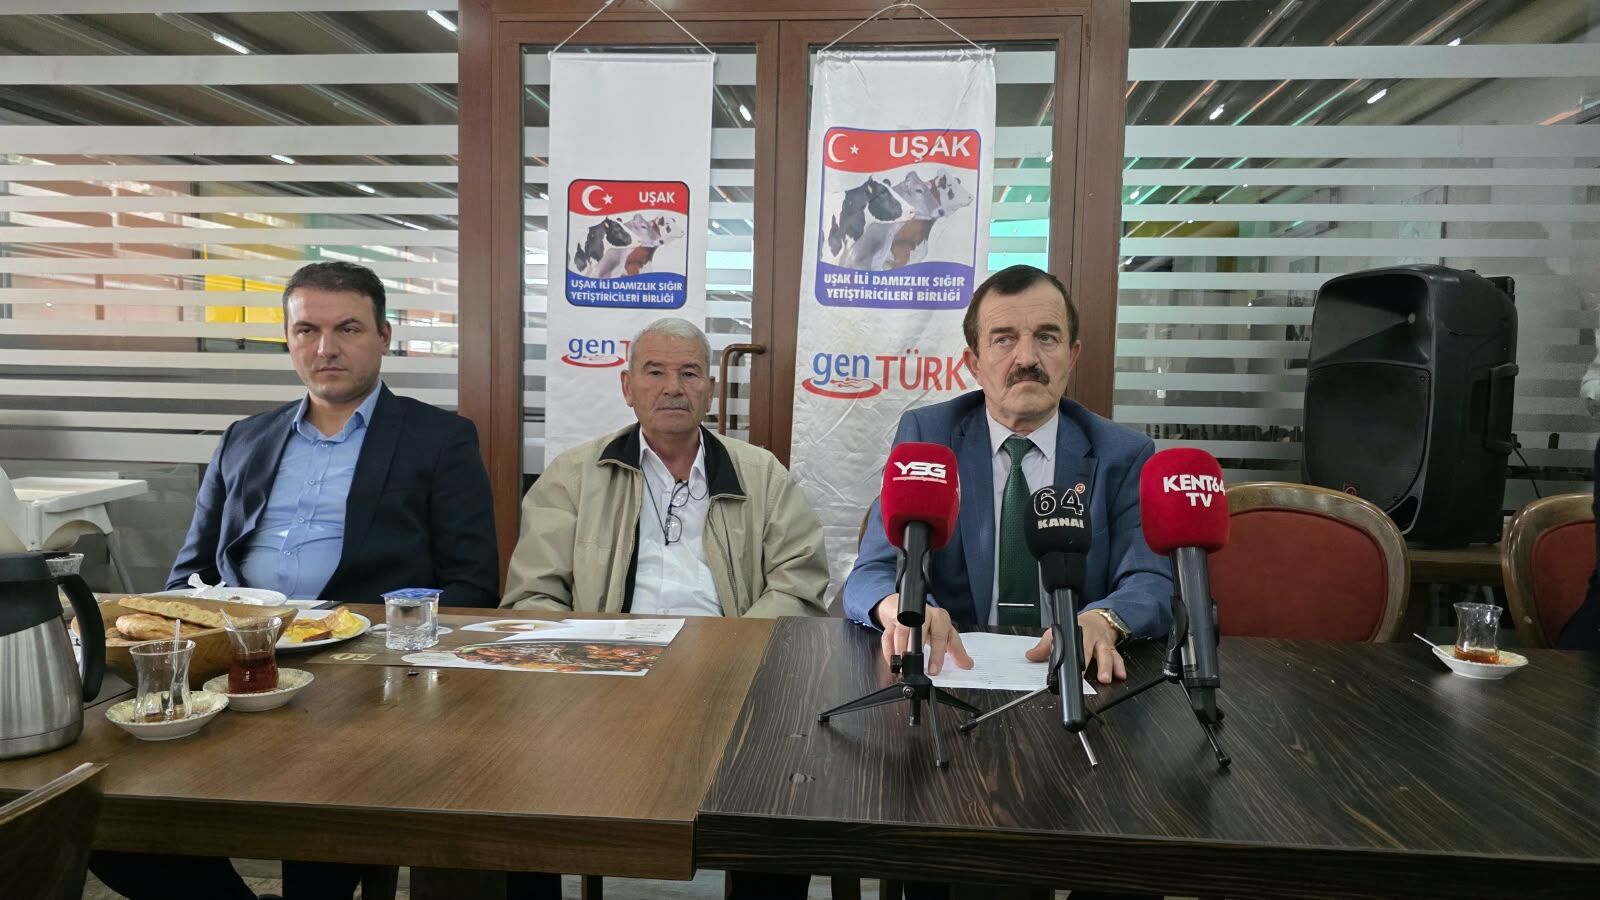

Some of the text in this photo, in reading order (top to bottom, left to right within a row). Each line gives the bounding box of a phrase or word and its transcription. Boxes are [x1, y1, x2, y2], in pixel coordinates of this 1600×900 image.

[889, 135, 971, 163] UŞAK
[639, 191, 676, 206] UŞAK
[571, 279, 683, 292] UŞAK İLİ DAMIZLIK SIĞIR
[823, 272, 965, 287] UŞAK İLİ DAMIZLIK SIĞIR
[571, 290, 674, 303] YETİŞTİRİCİLERİ BİRLİĞİ
[826, 286, 961, 302] YETİŞTİRİCİLERİ BİRLİĞİ
[893, 461, 946, 479] YSG
[1033, 488, 1084, 516] 64
[1185, 492, 1213, 507] TV
